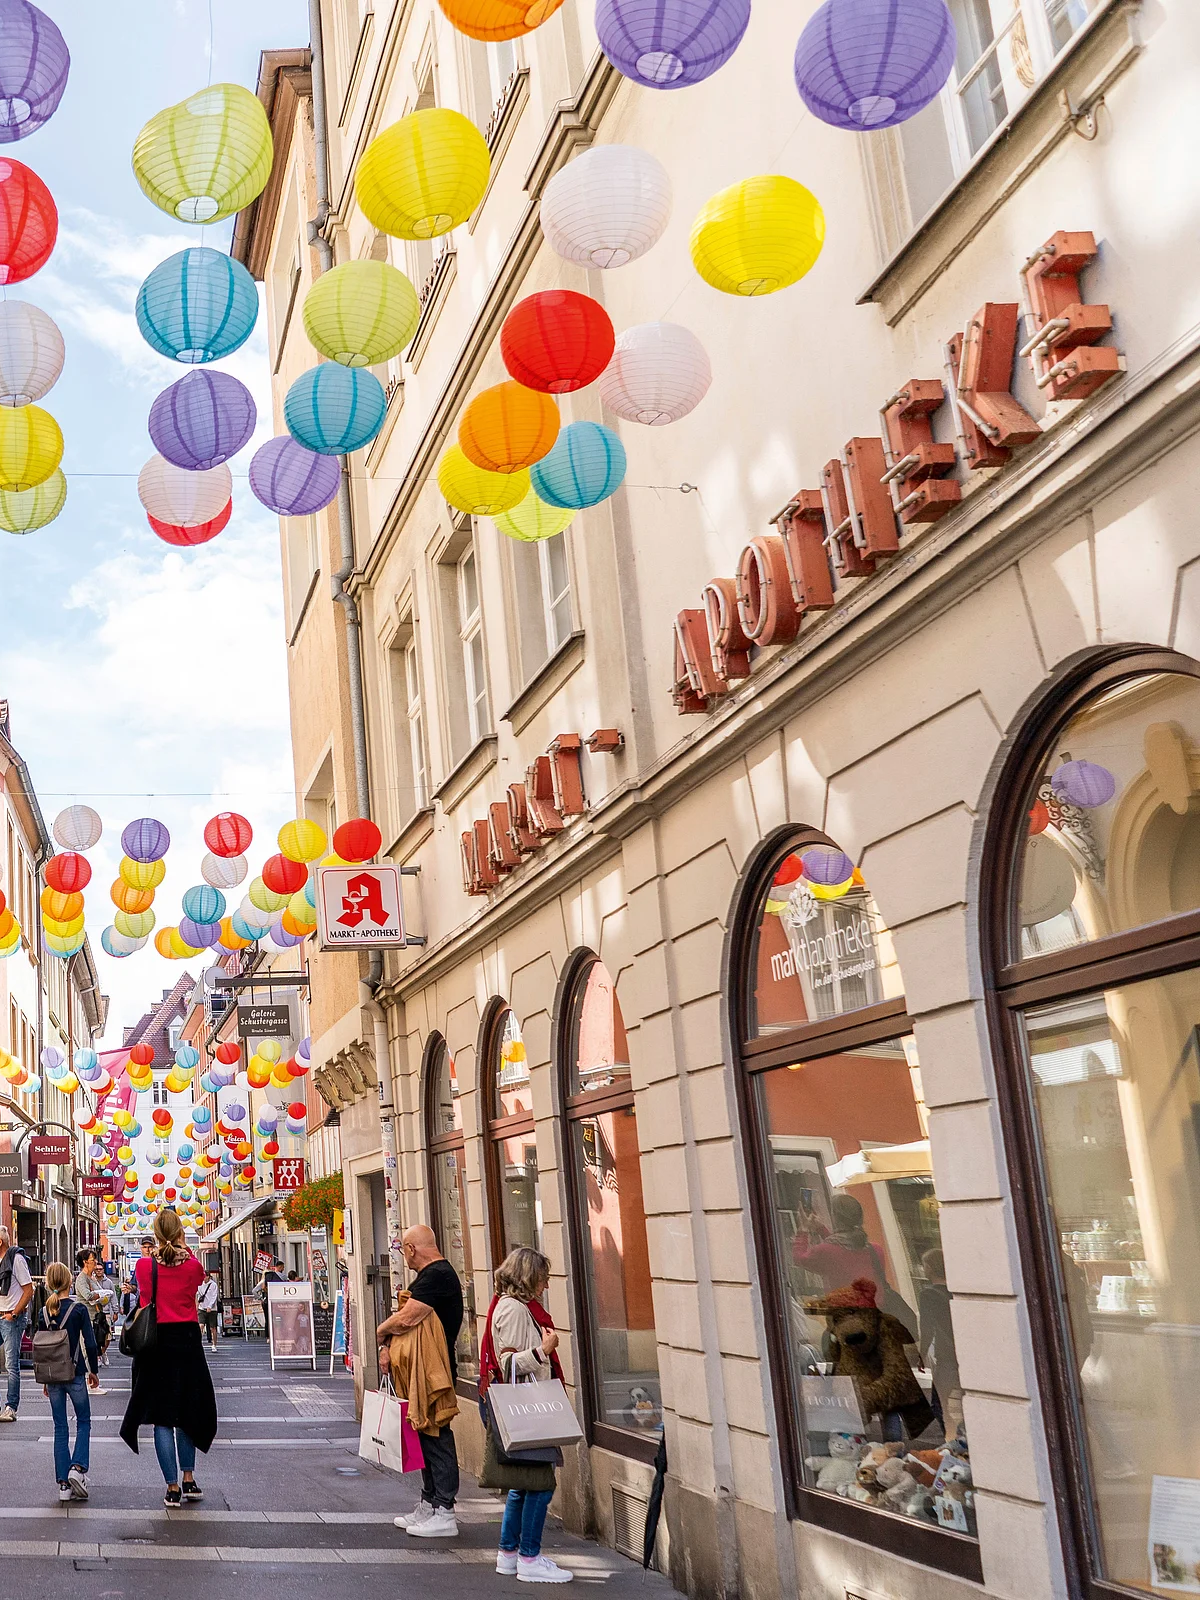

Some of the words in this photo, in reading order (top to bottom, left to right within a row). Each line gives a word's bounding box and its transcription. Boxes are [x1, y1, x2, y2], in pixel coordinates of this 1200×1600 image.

[251, 1009, 276, 1019] Galerie
[240, 1017, 288, 1027] Schustergasse
[225, 1133, 245, 1143] Leica
[34, 1145, 67, 1153] Schlier
[508, 1401, 564, 1416] momo
